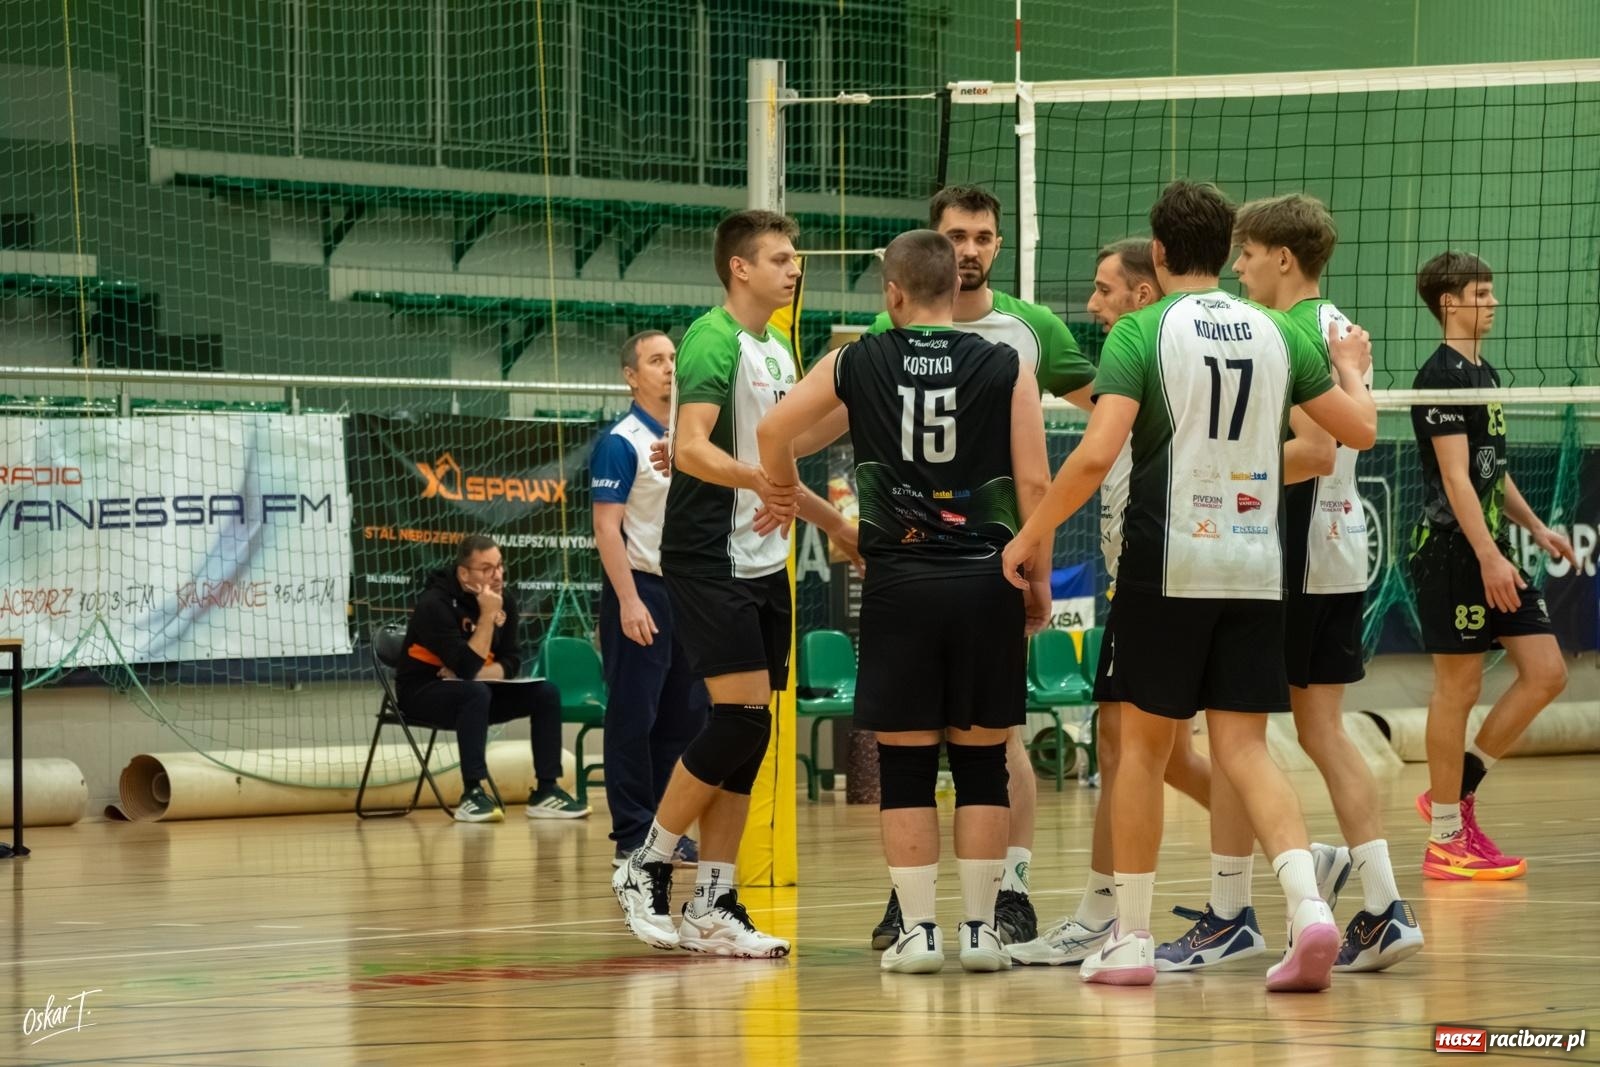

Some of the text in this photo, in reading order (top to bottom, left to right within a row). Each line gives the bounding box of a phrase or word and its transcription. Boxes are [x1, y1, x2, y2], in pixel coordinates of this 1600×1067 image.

[1193, 319, 1253, 342] KOZIELEC
[903, 355, 953, 376] KOSTKA
[1203, 355, 1254, 441] 17
[897, 385, 957, 463] 15
[1487, 402, 1506, 436] 83
[465, 476, 568, 503] SPAWX
[1192, 494, 1223, 505] PIVEXIN
[262, 494, 332, 524] FM
[364, 526, 396, 541] STAL
[399, 529, 465, 545] NIERDZEW
[558, 536, 597, 549] WYDA
[125, 584, 156, 614] FM
[310, 578, 335, 606] FM
[1455, 604, 1486, 630] 83
